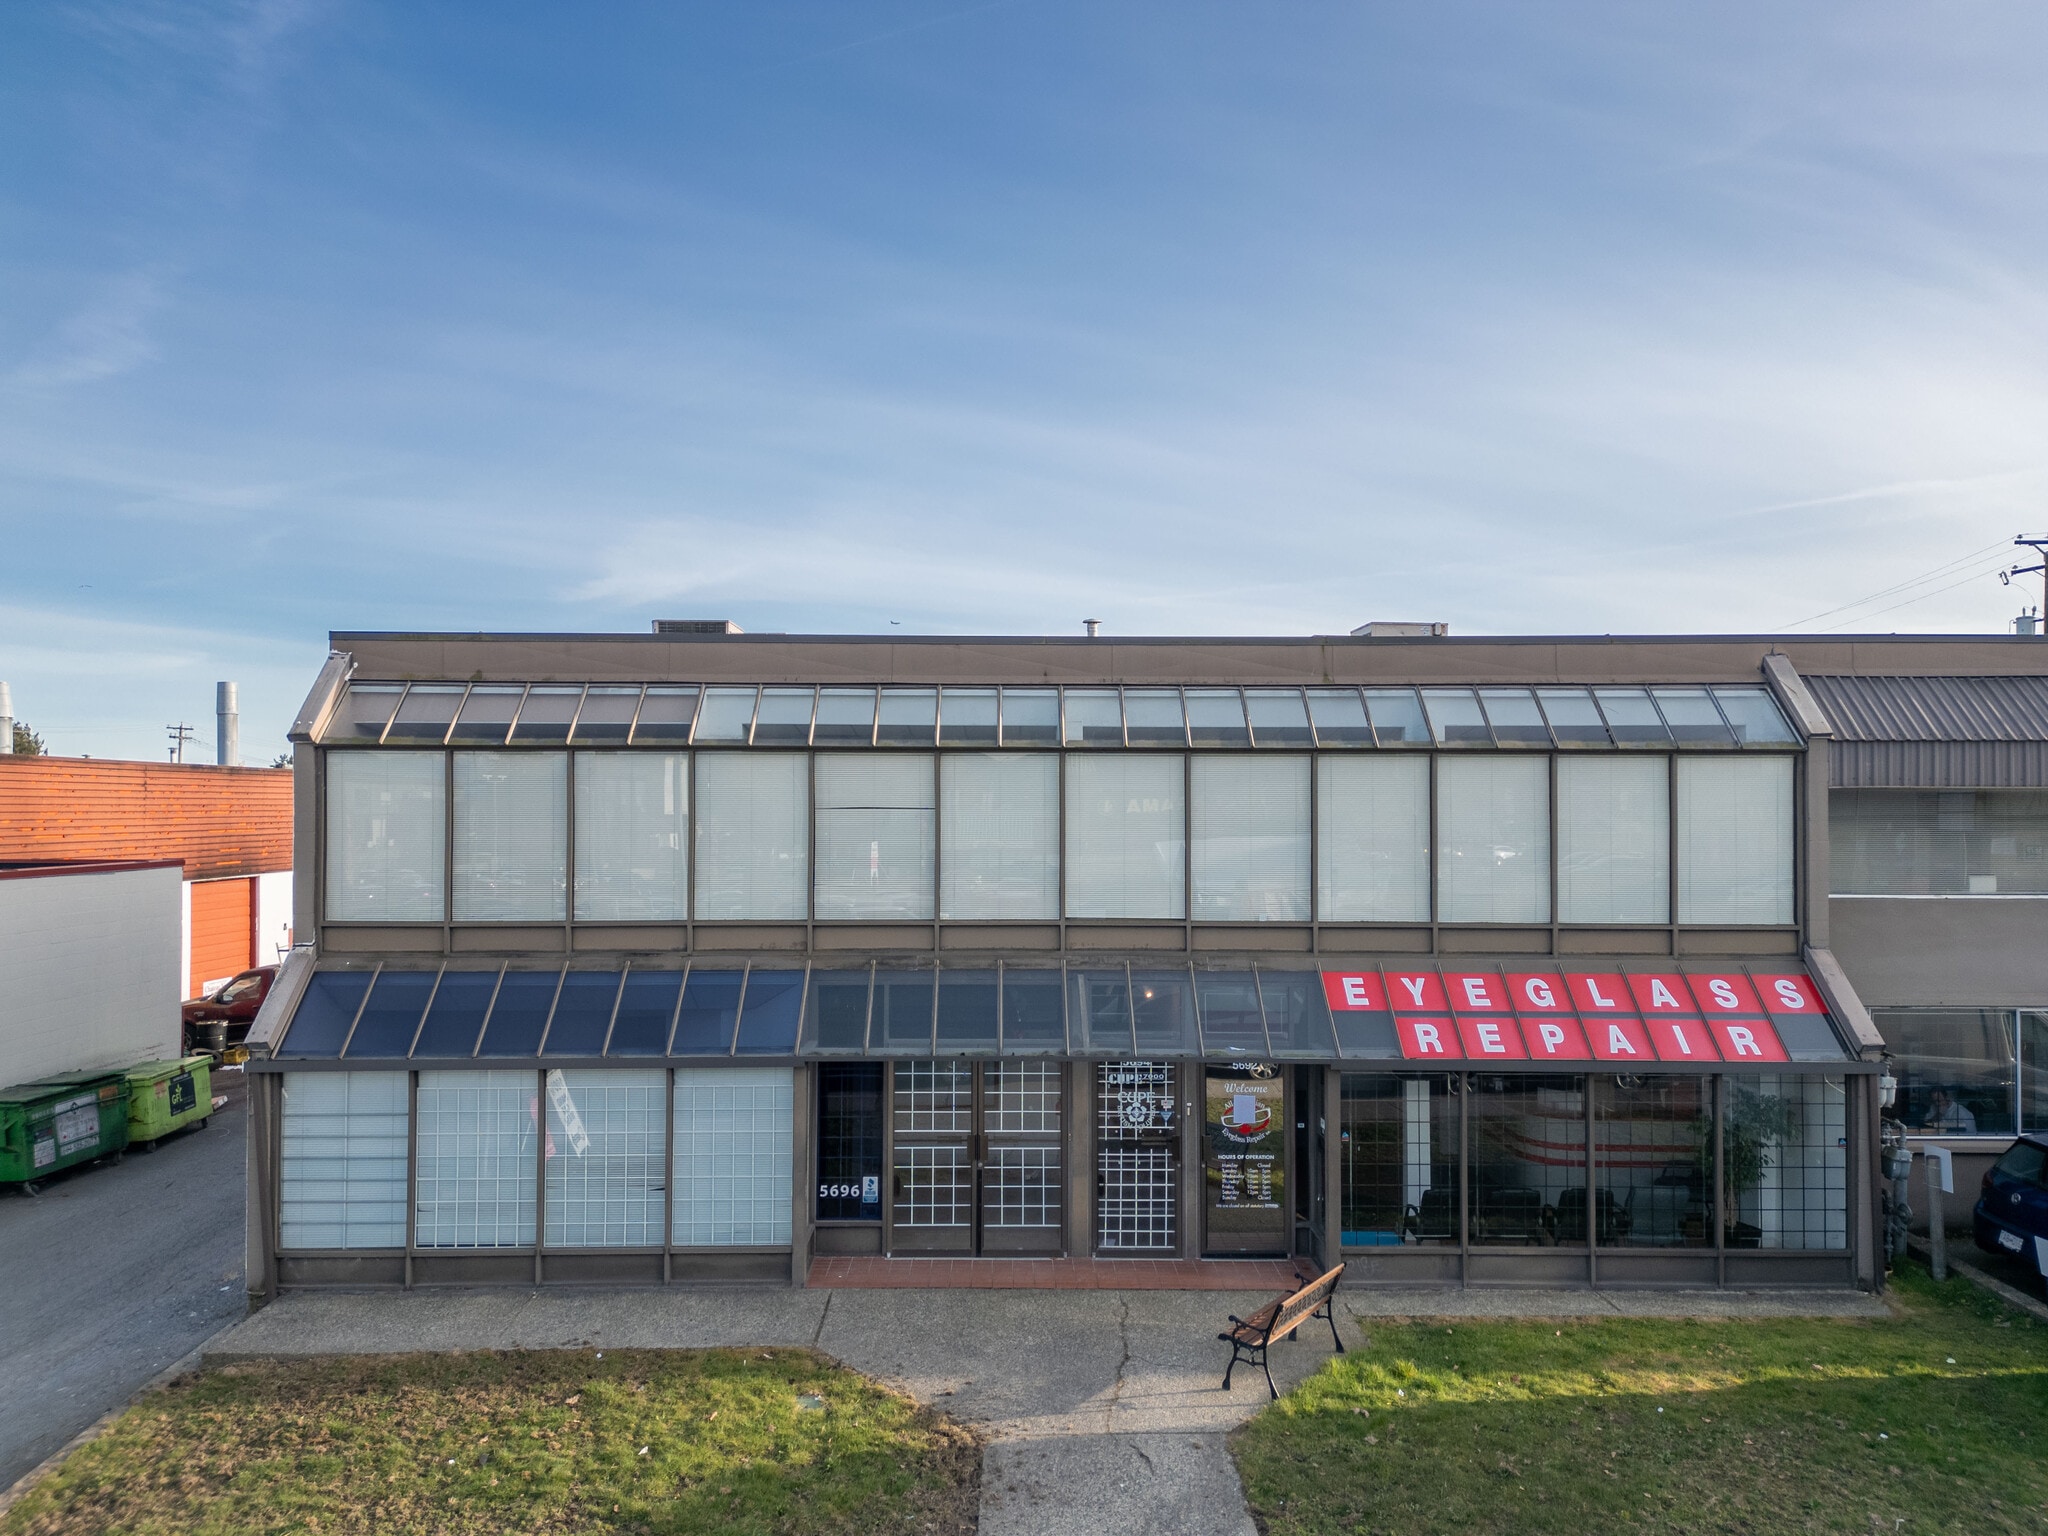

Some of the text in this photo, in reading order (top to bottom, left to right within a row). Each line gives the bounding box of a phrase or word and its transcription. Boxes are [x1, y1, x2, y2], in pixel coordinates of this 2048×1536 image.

[1342, 977, 1805, 1009] EYEGLASS
[1414, 1023, 1762, 1056] REPAIR
[1224, 1083, 1268, 1093] Welcome
[1117, 1091, 1156, 1103] CUPE
[819, 1184, 860, 1198] 5696
